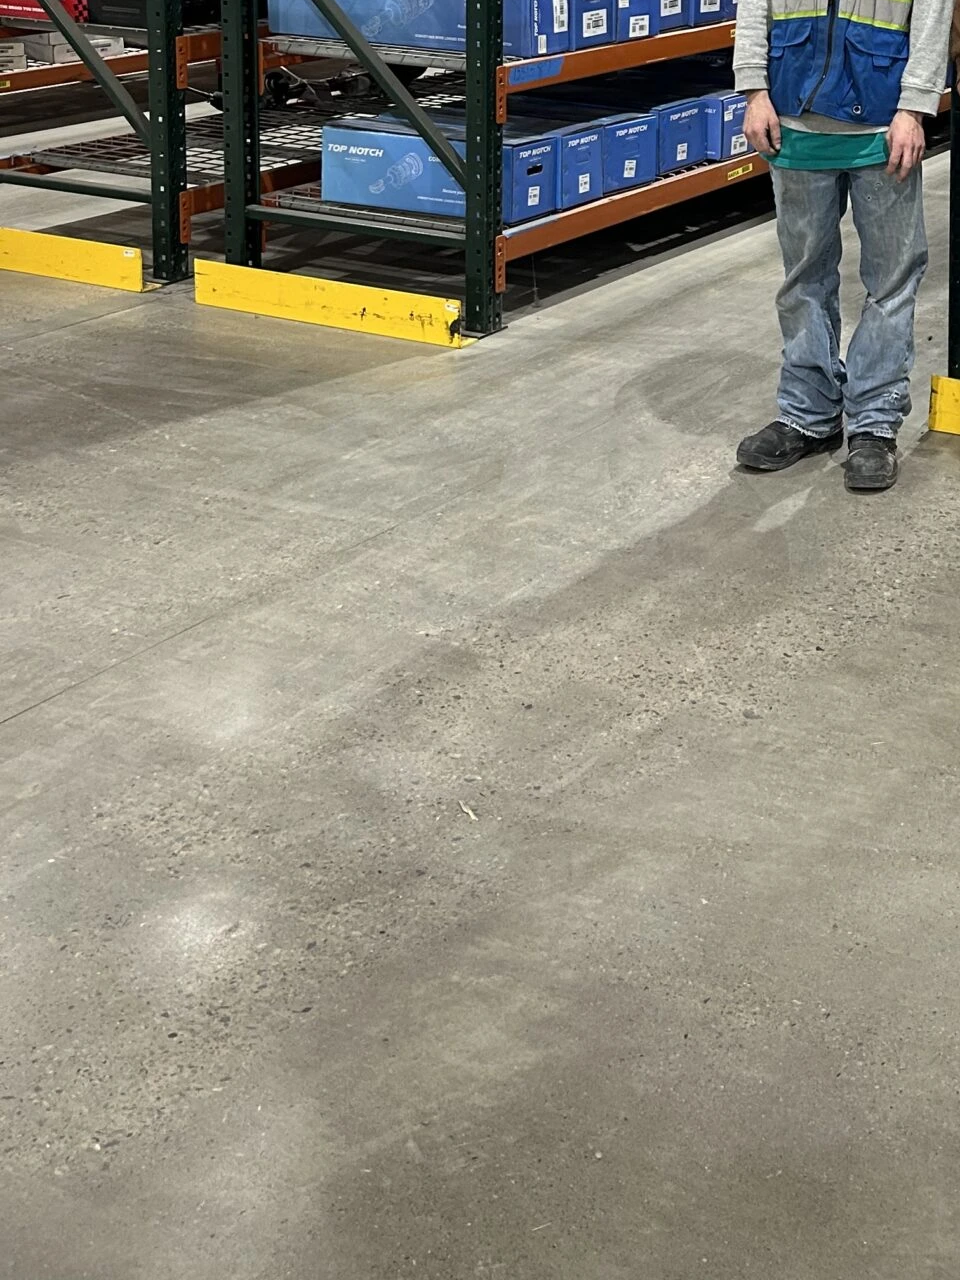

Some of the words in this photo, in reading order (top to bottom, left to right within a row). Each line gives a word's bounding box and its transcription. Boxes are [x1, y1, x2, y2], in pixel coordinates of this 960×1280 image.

[670, 113, 681, 121] TOP
[682, 108, 698, 119] NOTCH
[616, 129, 629, 137] TOP
[630, 125, 648, 135] NOTCH
[568, 140, 580, 148] TOP
[580, 135, 598, 146] NOTCH
[327, 143, 348, 154] TOP
[349, 144, 384, 157] NOTCH
[532, 146, 551, 157] NOTCH
